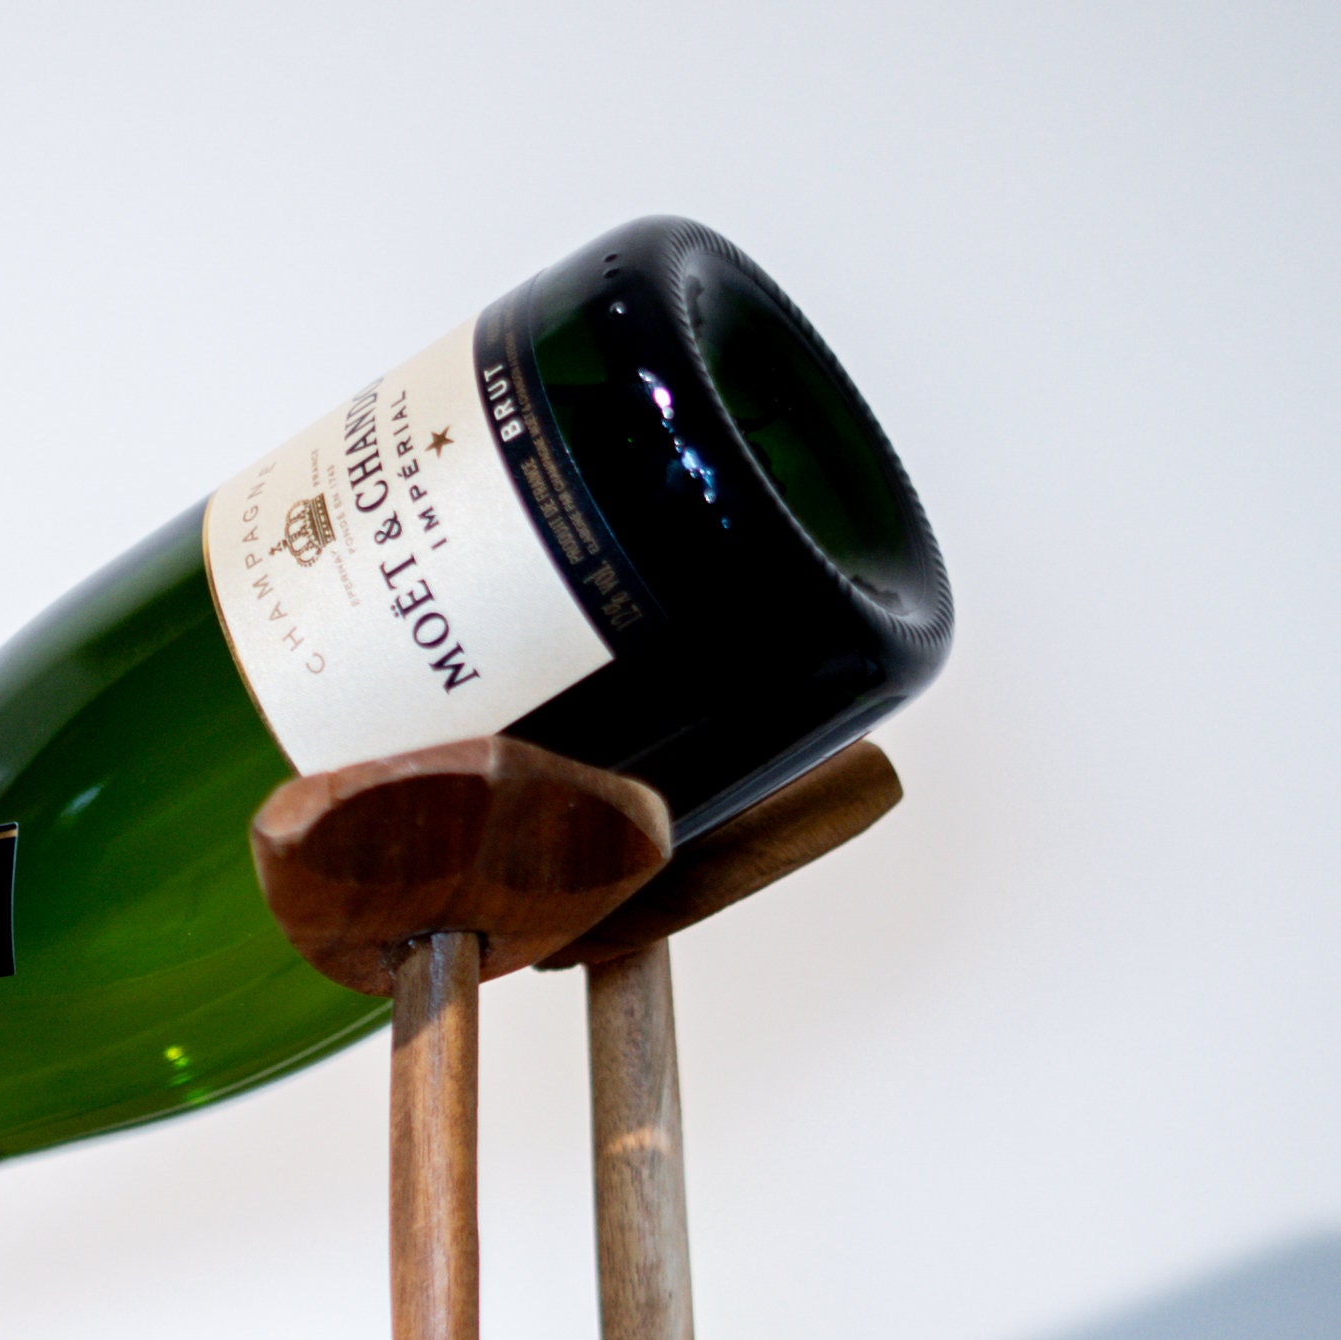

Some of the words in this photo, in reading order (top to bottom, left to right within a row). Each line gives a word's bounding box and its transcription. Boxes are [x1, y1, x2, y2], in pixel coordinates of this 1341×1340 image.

[483, 364, 525, 443] BRUT
[344, 376, 389, 514] CHANDO
[392, 389, 448, 550] IMPÉRIAL
[521, 457, 550, 503] FRANCE
[373, 512, 403, 546] &
[529, 498, 559, 519] DE
[547, 516, 584, 565] PRODUIT
[241, 461, 326, 675] CHAMPAGNE
[379, 555, 481, 694] MOËT
